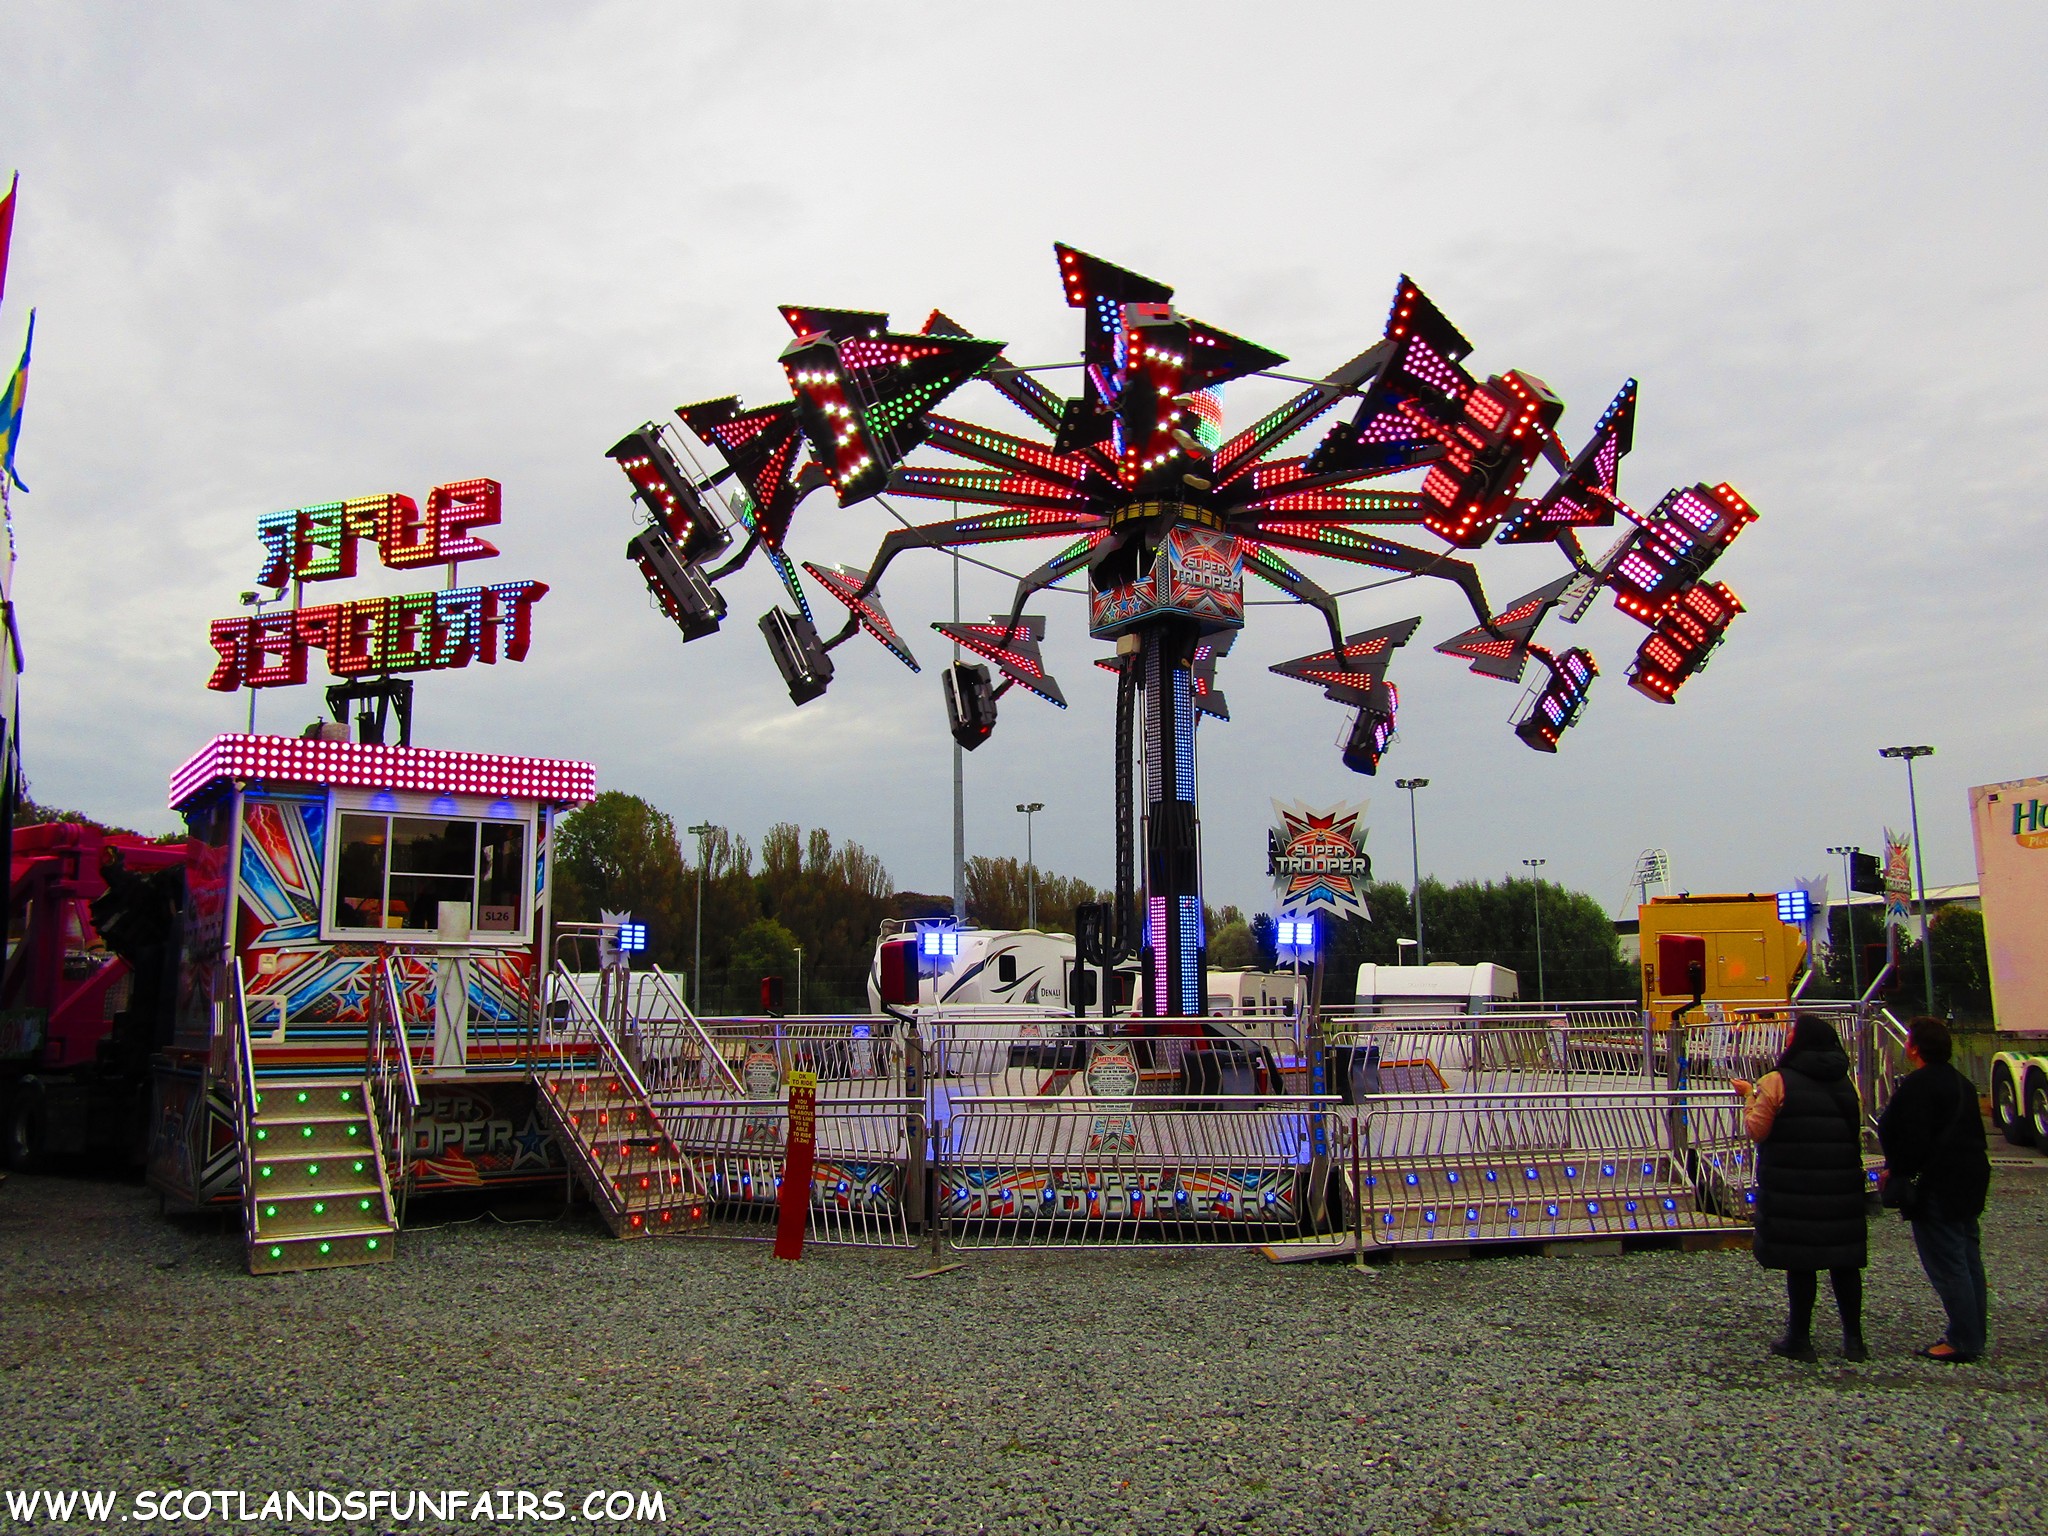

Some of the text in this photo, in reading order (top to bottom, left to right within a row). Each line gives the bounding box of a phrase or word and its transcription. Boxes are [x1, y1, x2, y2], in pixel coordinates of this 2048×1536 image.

[1186, 557, 1228, 577] SUPER
[1175, 568, 1241, 593] TROOPER
[1294, 844, 1346, 857] SUPER
[1275, 856, 1367, 875] TROOPER
[485, 911, 510, 921] SL26
[1062, 1171, 1164, 1191] SUPER
